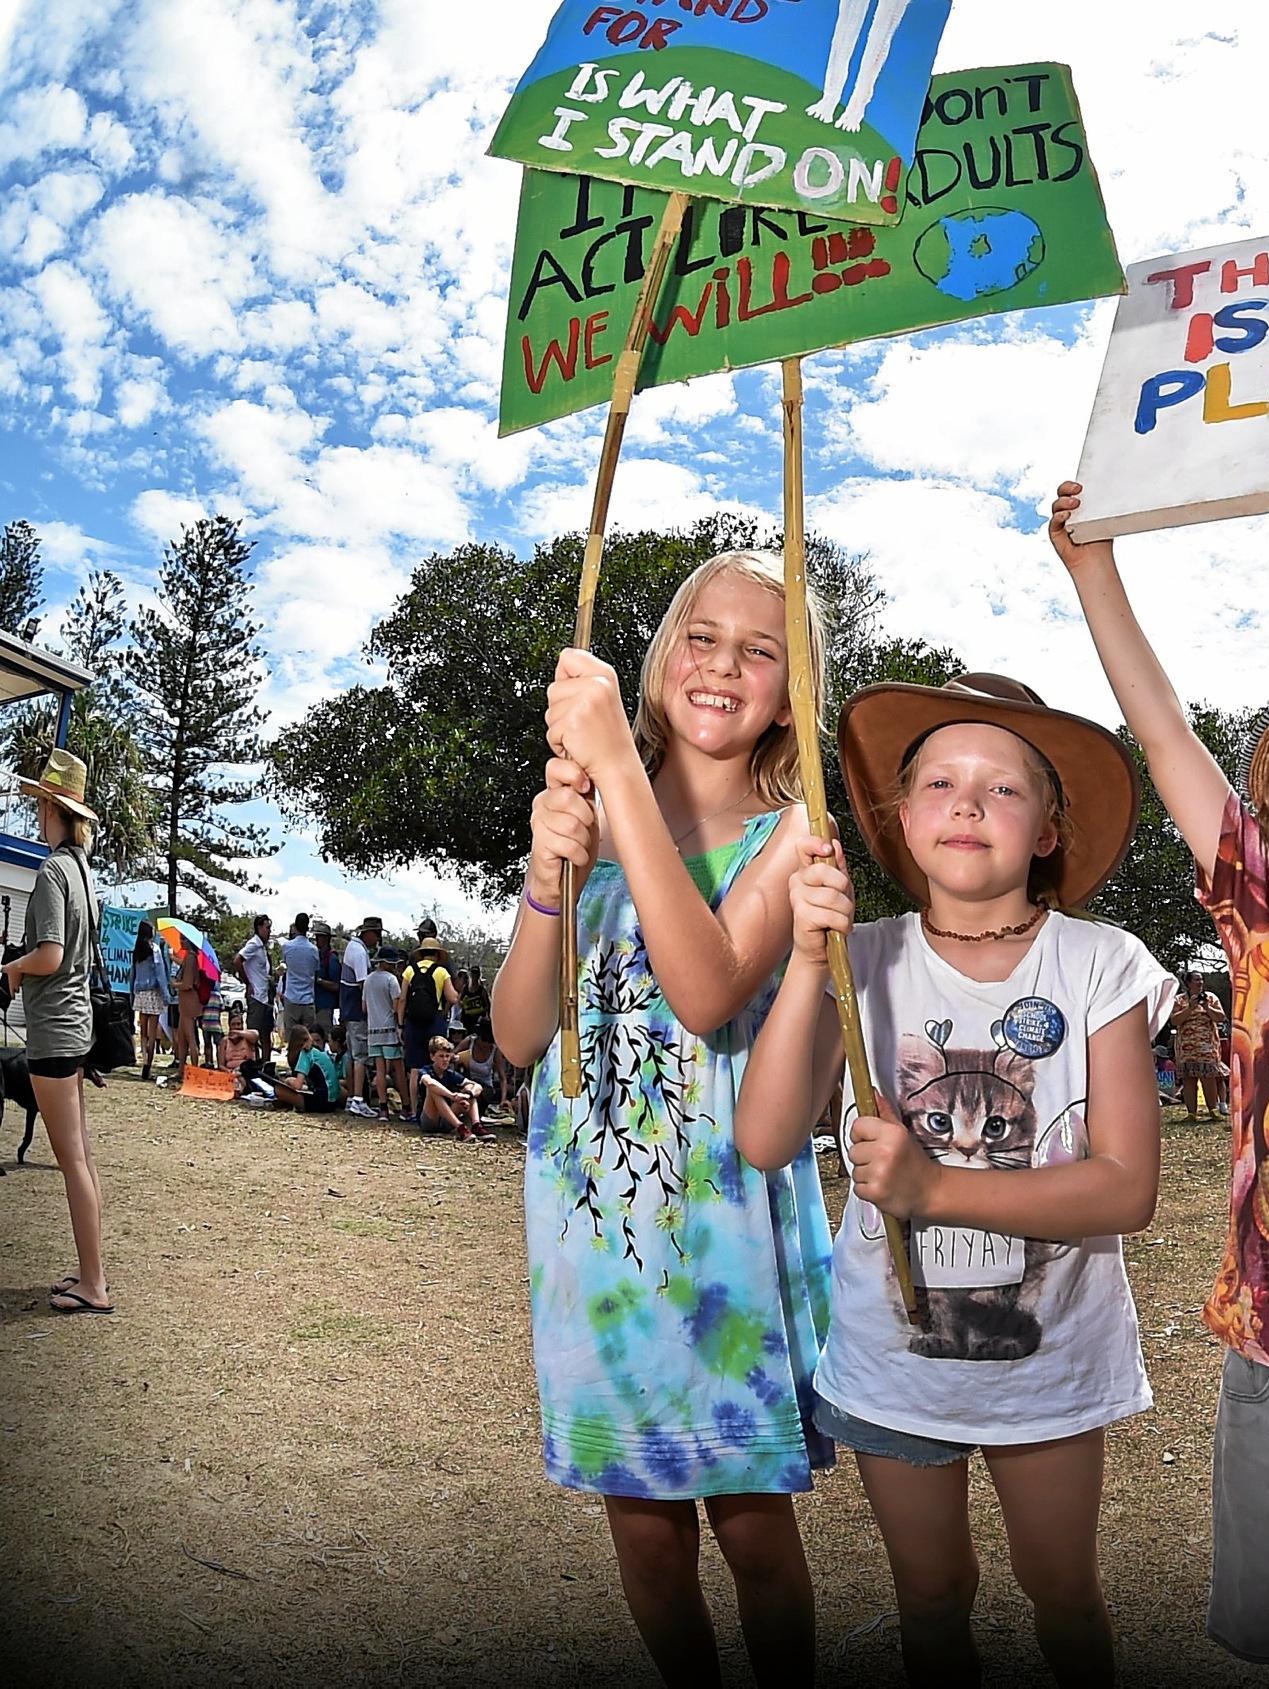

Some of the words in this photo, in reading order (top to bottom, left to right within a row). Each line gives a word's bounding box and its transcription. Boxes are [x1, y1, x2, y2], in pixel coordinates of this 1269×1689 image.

[582, 6, 682, 51] FOR
[564, 63, 620, 104] IS
[619, 70, 787, 143] WHAT
[538, 107, 588, 151] I
[594, 117, 787, 188] STAND
[518, 215, 654, 322] ACT
[906, 121, 1083, 209] DULTS
[522, 311, 613, 394] WE
[103, 909, 138, 935] STRIKE
[918, 1227, 1013, 1268] FRIYAY
